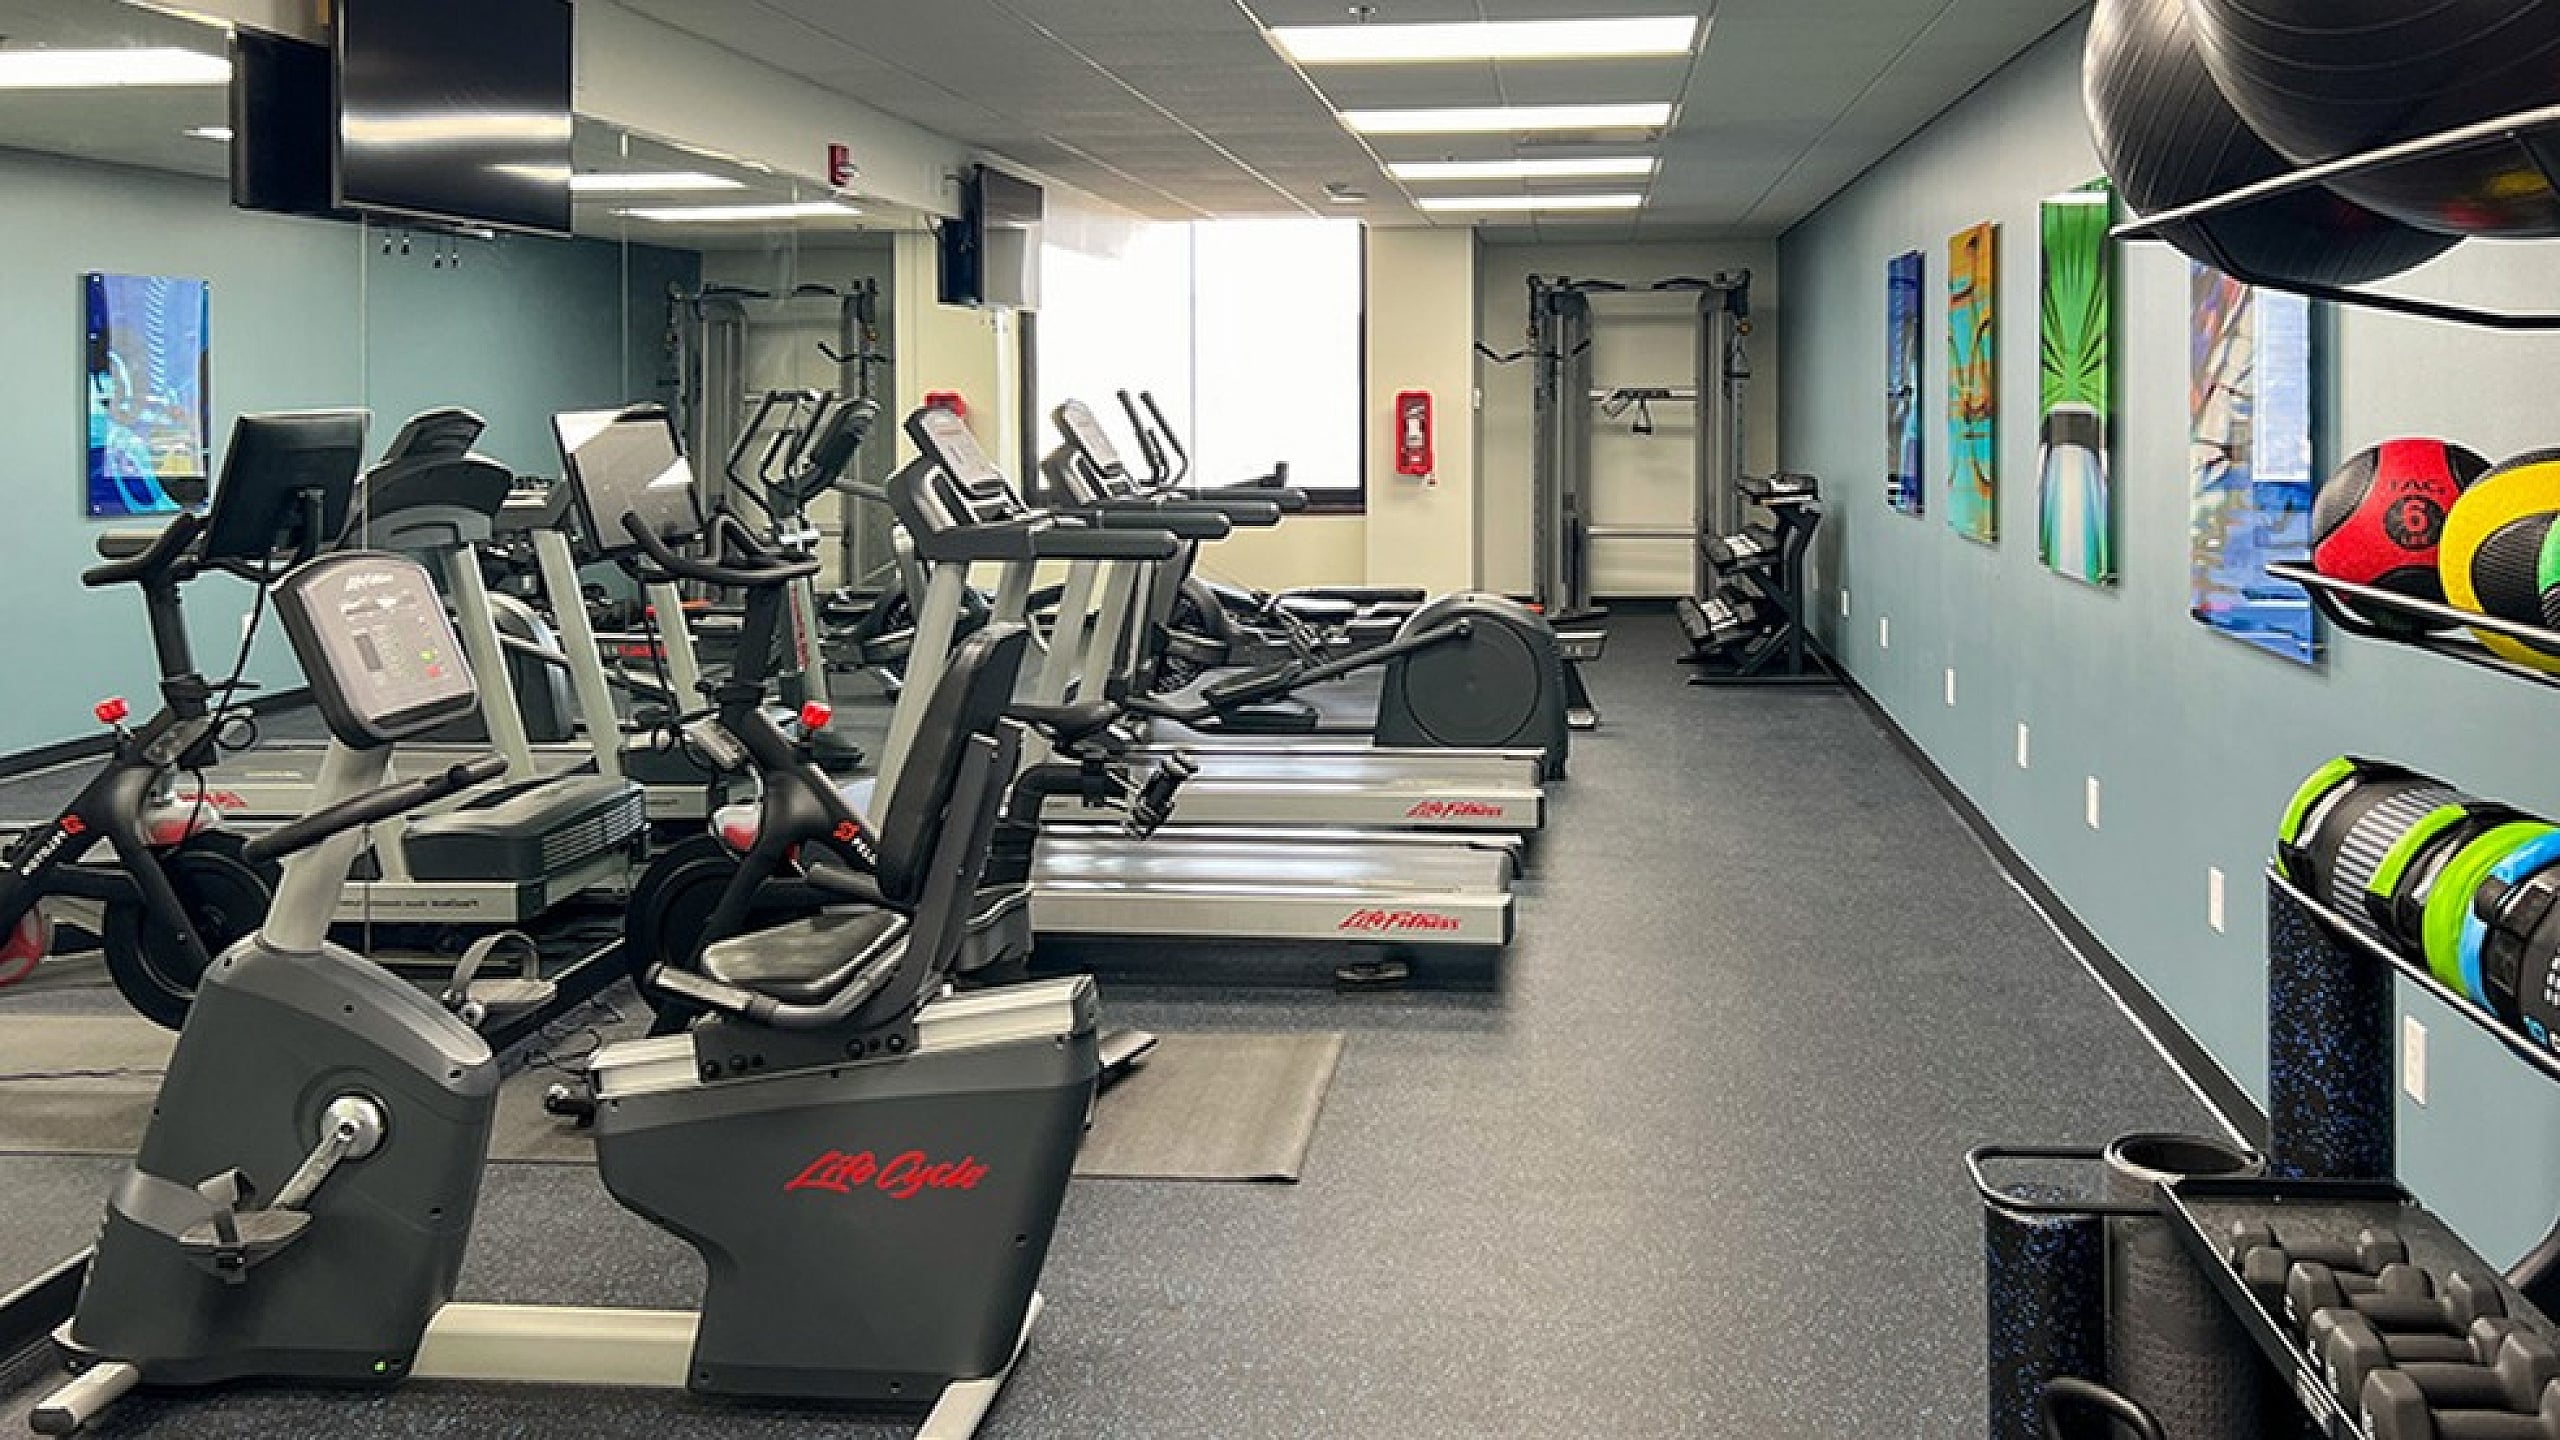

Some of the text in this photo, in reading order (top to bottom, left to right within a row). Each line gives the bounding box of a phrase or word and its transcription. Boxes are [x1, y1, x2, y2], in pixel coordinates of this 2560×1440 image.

[2403, 499, 2428, 533] 6
[784, 1149, 990, 1199] Life Cycle
